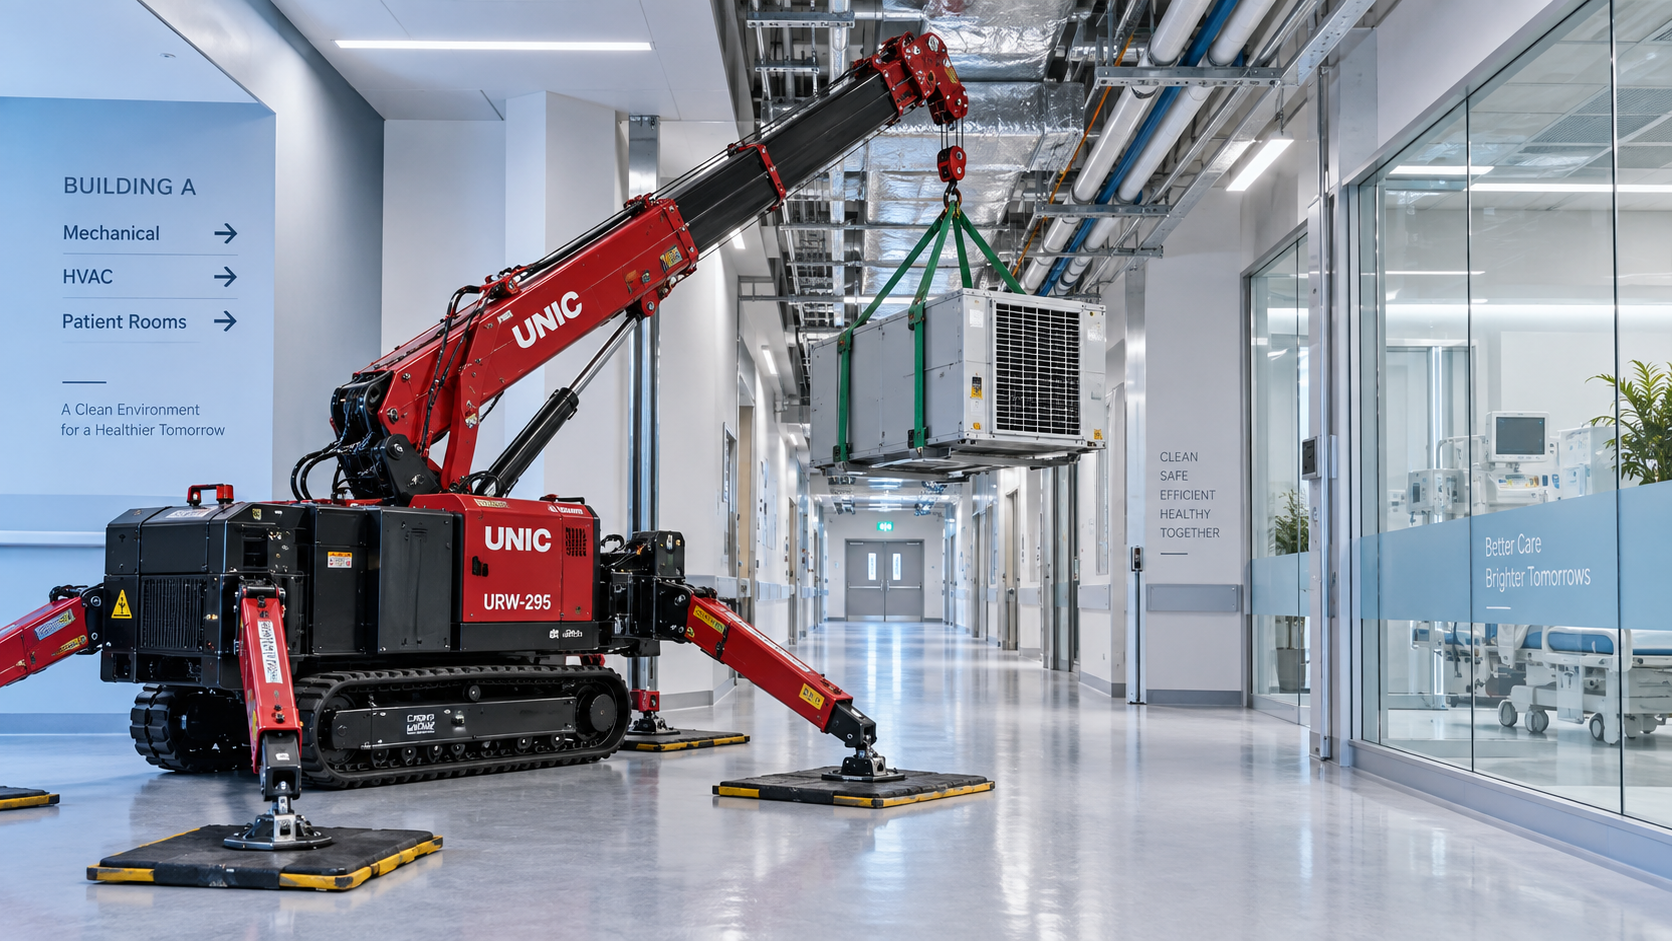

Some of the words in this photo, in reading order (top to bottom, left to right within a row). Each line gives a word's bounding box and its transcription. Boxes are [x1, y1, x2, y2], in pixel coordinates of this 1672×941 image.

[64, 177, 172, 195] BUILDING
[181, 178, 197, 195] A
[63, 225, 160, 240] Mechanical
[63, 269, 113, 284] HVAC
[62, 314, 124, 329] Patient
[129, 314, 187, 329] Rooms
[511, 291, 582, 348] UNIC
[60, 403, 71, 416] A
[75, 403, 113, 416] Clean
[117, 403, 200, 416] Environment
[61, 423, 79, 436] for
[83, 426, 91, 437] a
[95, 423, 156, 436] Healthier
[158, 423, 226, 436] Tomorrow
[1160, 451, 1198, 463] CLEAN
[1160, 470, 1188, 482] SAFE
[1160, 489, 1216, 501] EFFICIENT
[1160, 508, 1211, 520] HEALTHY
[485, 526, 551, 552] UNIC
[1160, 527, 1220, 539] TOGETHER
[1485, 536, 1515, 558] Better
[1517, 533, 1542, 554] Care
[1485, 566, 1526, 592] Brighter
[1527, 565, 1591, 587] Tomorrows
[483, 593, 552, 611] URW-295
